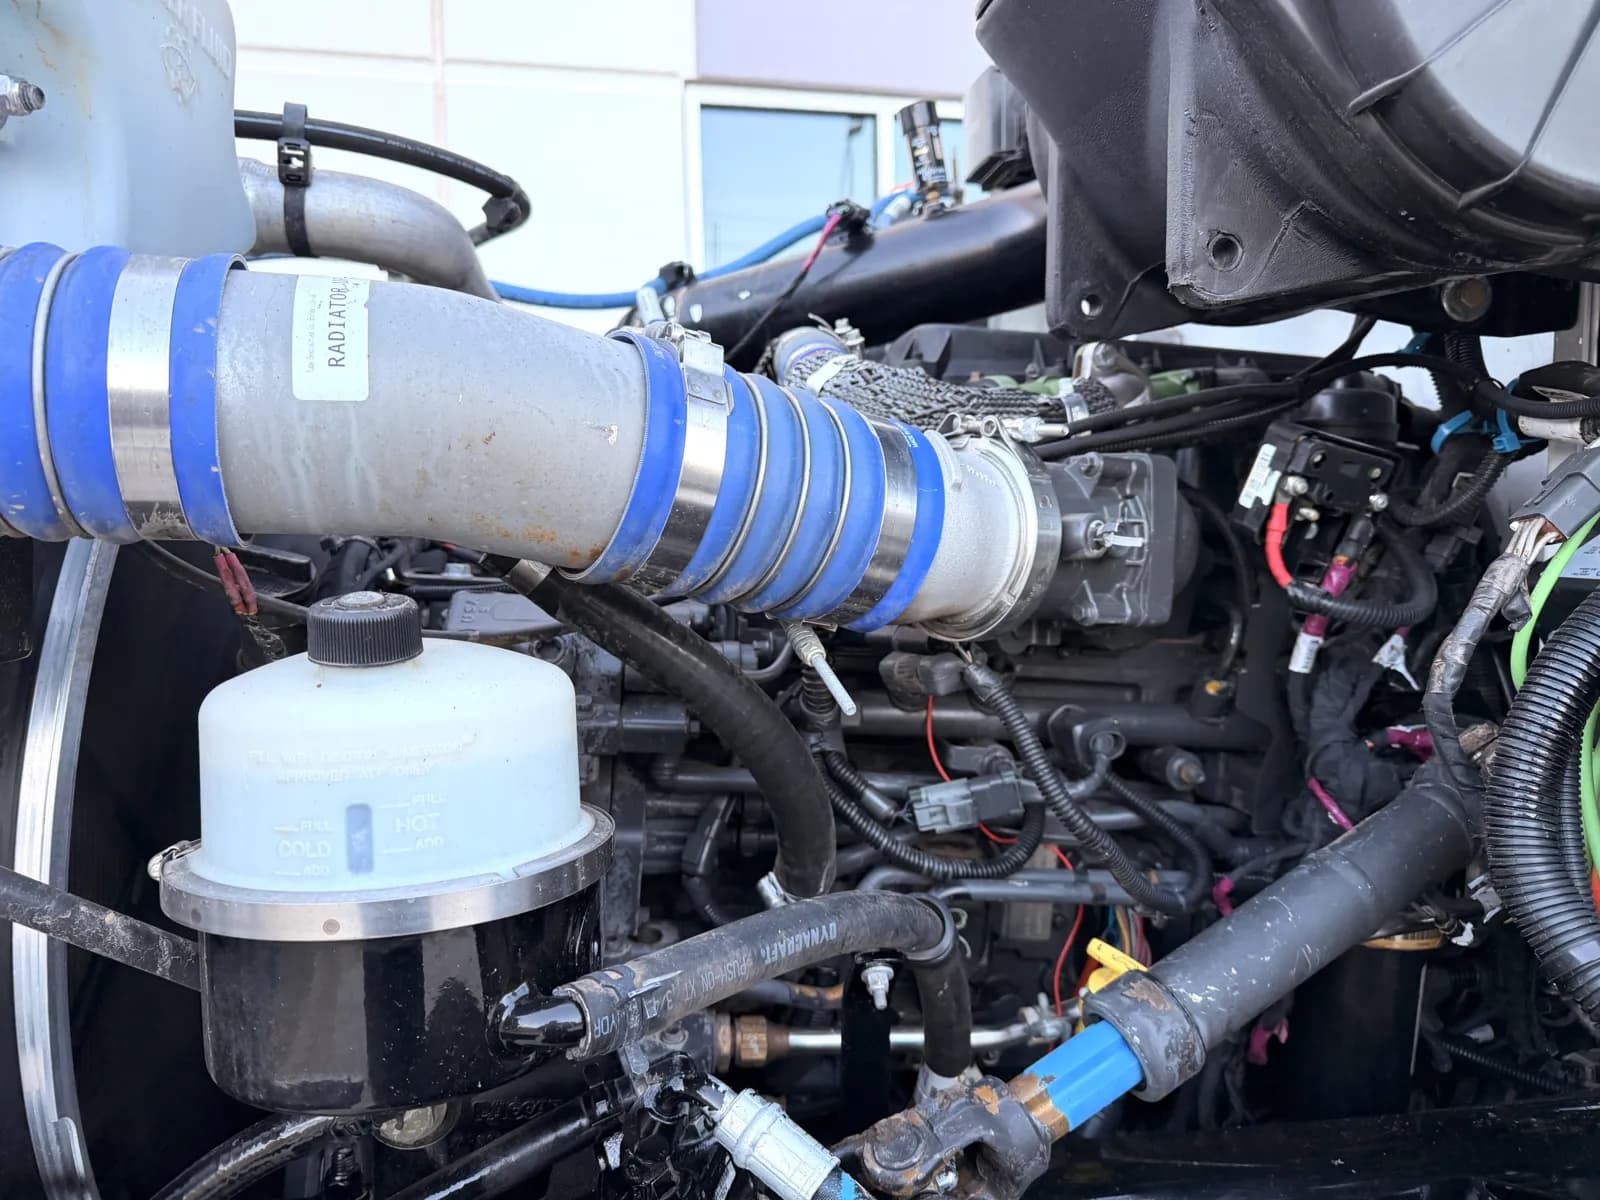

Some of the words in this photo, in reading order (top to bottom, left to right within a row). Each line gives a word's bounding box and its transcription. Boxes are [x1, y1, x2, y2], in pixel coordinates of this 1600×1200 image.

[396, 812, 440, 833] HOT
[278, 839, 331, 858] COLD
[416, 836, 445, 851] ADD
